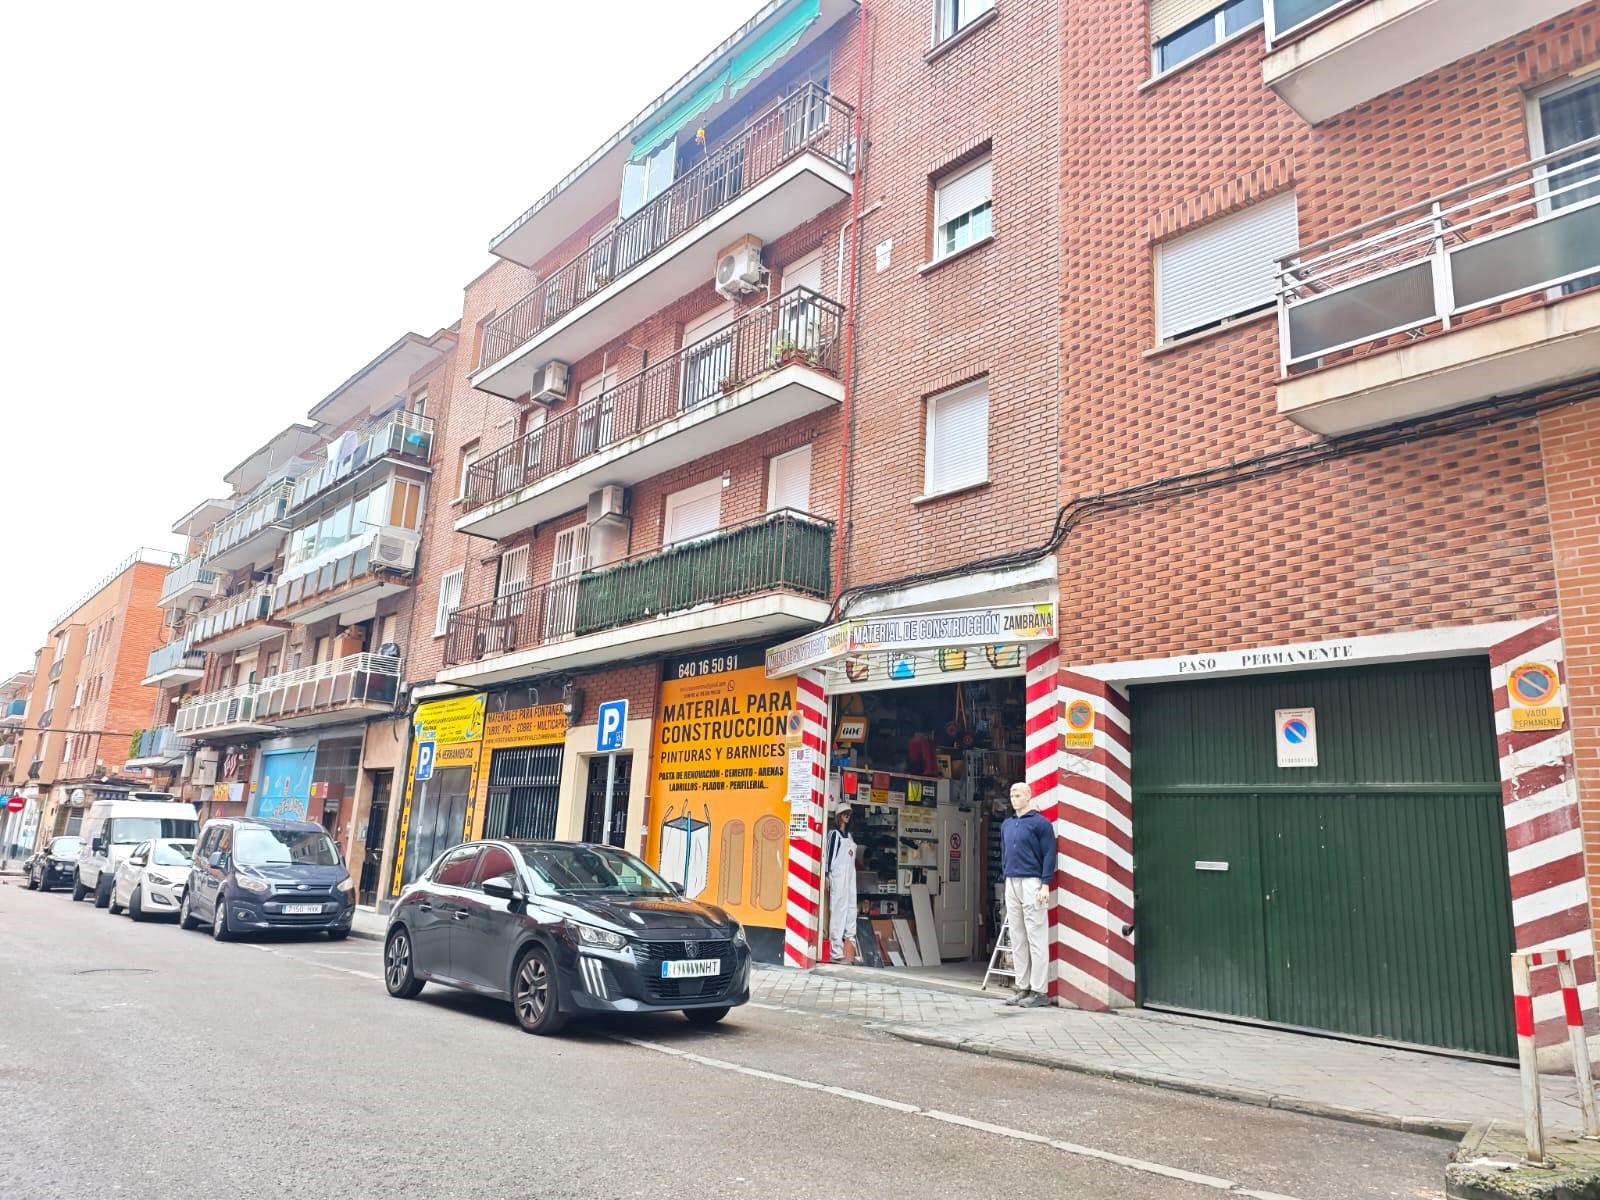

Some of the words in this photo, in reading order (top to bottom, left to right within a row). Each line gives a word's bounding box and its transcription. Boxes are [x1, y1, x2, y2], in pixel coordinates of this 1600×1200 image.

[852, 622, 903, 644] MATERIAL
[903, 620, 918, 640] DE
[919, 611, 1000, 639] CONSTRUCCIÓN
[1004, 613, 1053, 630] ZAMBRANA
[678, 662, 696, 678] 640
[698, 660, 709, 675] 16
[711, 658, 724, 672] 50
[726, 655, 738, 670] 91
[1179, 658, 1217, 672] PASO
[1241, 645, 1353, 667] PERMANENTE
[488, 711, 517, 723] MATERIALES
[520, 707, 532, 719] PARA
[663, 697, 740, 723] MATERIAL
[747, 691, 792, 713] PARA
[1526, 709, 1547, 717] VADO
[602, 708, 619, 744] P
[662, 713, 788, 744] CONSTRUCCIÓN
[419, 746, 430, 774] P
[660, 748, 711, 764] PINTURAS
[716, 748, 723, 760] Y
[726, 743, 785, 760] BARNICES
[658, 770, 675, 781] PASTA
[676, 770, 683, 780] DE
[683, 768, 720, 780] RENOVACIÓN
[724, 768, 753, 778] CEMENTO
[758, 766, 784, 776] ARENAS
[669, 782, 698, 792] LADRILLOS
[702, 781, 725, 790] PLADUR
